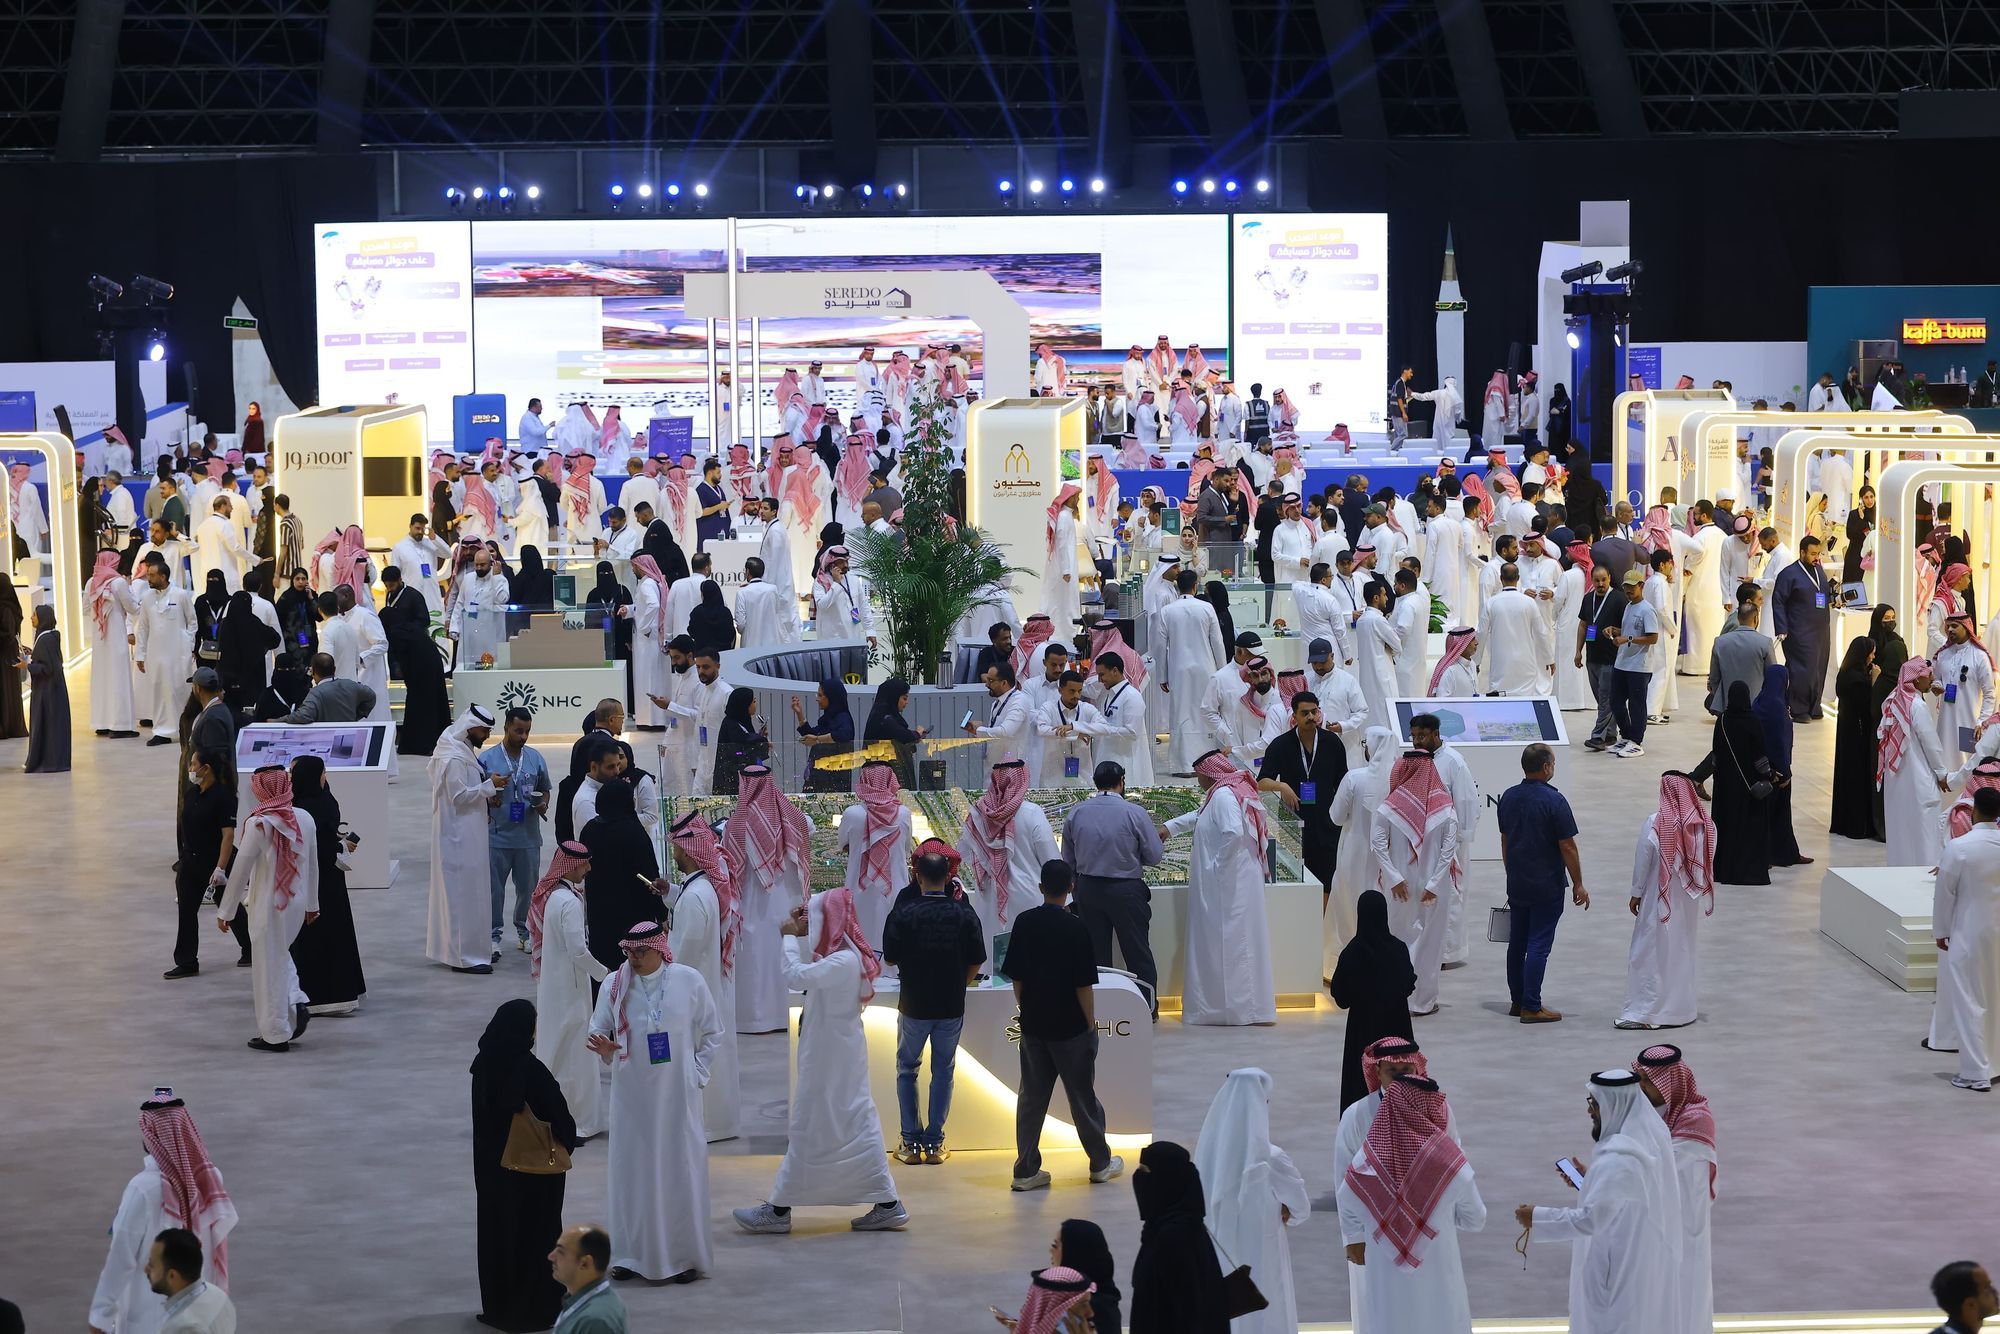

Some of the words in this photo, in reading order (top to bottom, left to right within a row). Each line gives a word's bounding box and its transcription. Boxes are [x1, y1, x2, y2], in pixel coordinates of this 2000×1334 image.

[824, 287, 882, 299] SEREDO
[1903, 319, 1942, 344] kaffa
[1946, 322, 1986, 339] bunn
[542, 695, 582, 708] NHC
[1094, 1019, 1131, 1037] HC
